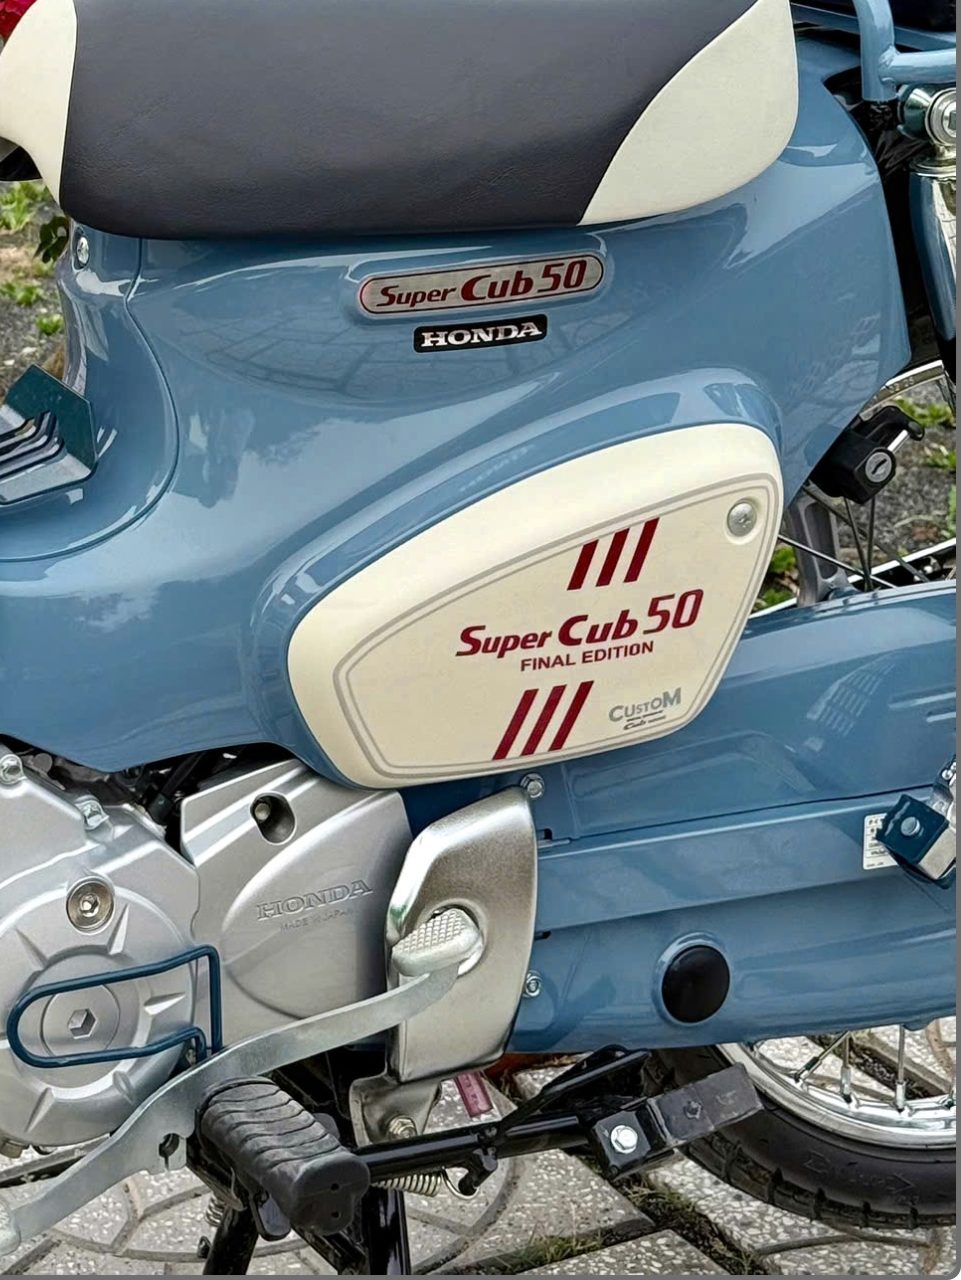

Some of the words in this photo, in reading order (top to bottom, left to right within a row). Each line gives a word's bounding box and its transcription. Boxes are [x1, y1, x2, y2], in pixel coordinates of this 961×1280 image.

[376, 285, 457, 308] Super
[460, 270, 534, 301] Cub
[537, 259, 588, 293] 50
[420, 321, 542, 347] HONDA
[455, 625, 552, 658] Super
[558, 609, 639, 647] Cub
[642, 588, 704, 635] 50
[520, 653, 576, 671] FINAL
[581, 640, 654, 664] EDITION
[256, 879, 374, 921] HONDA
